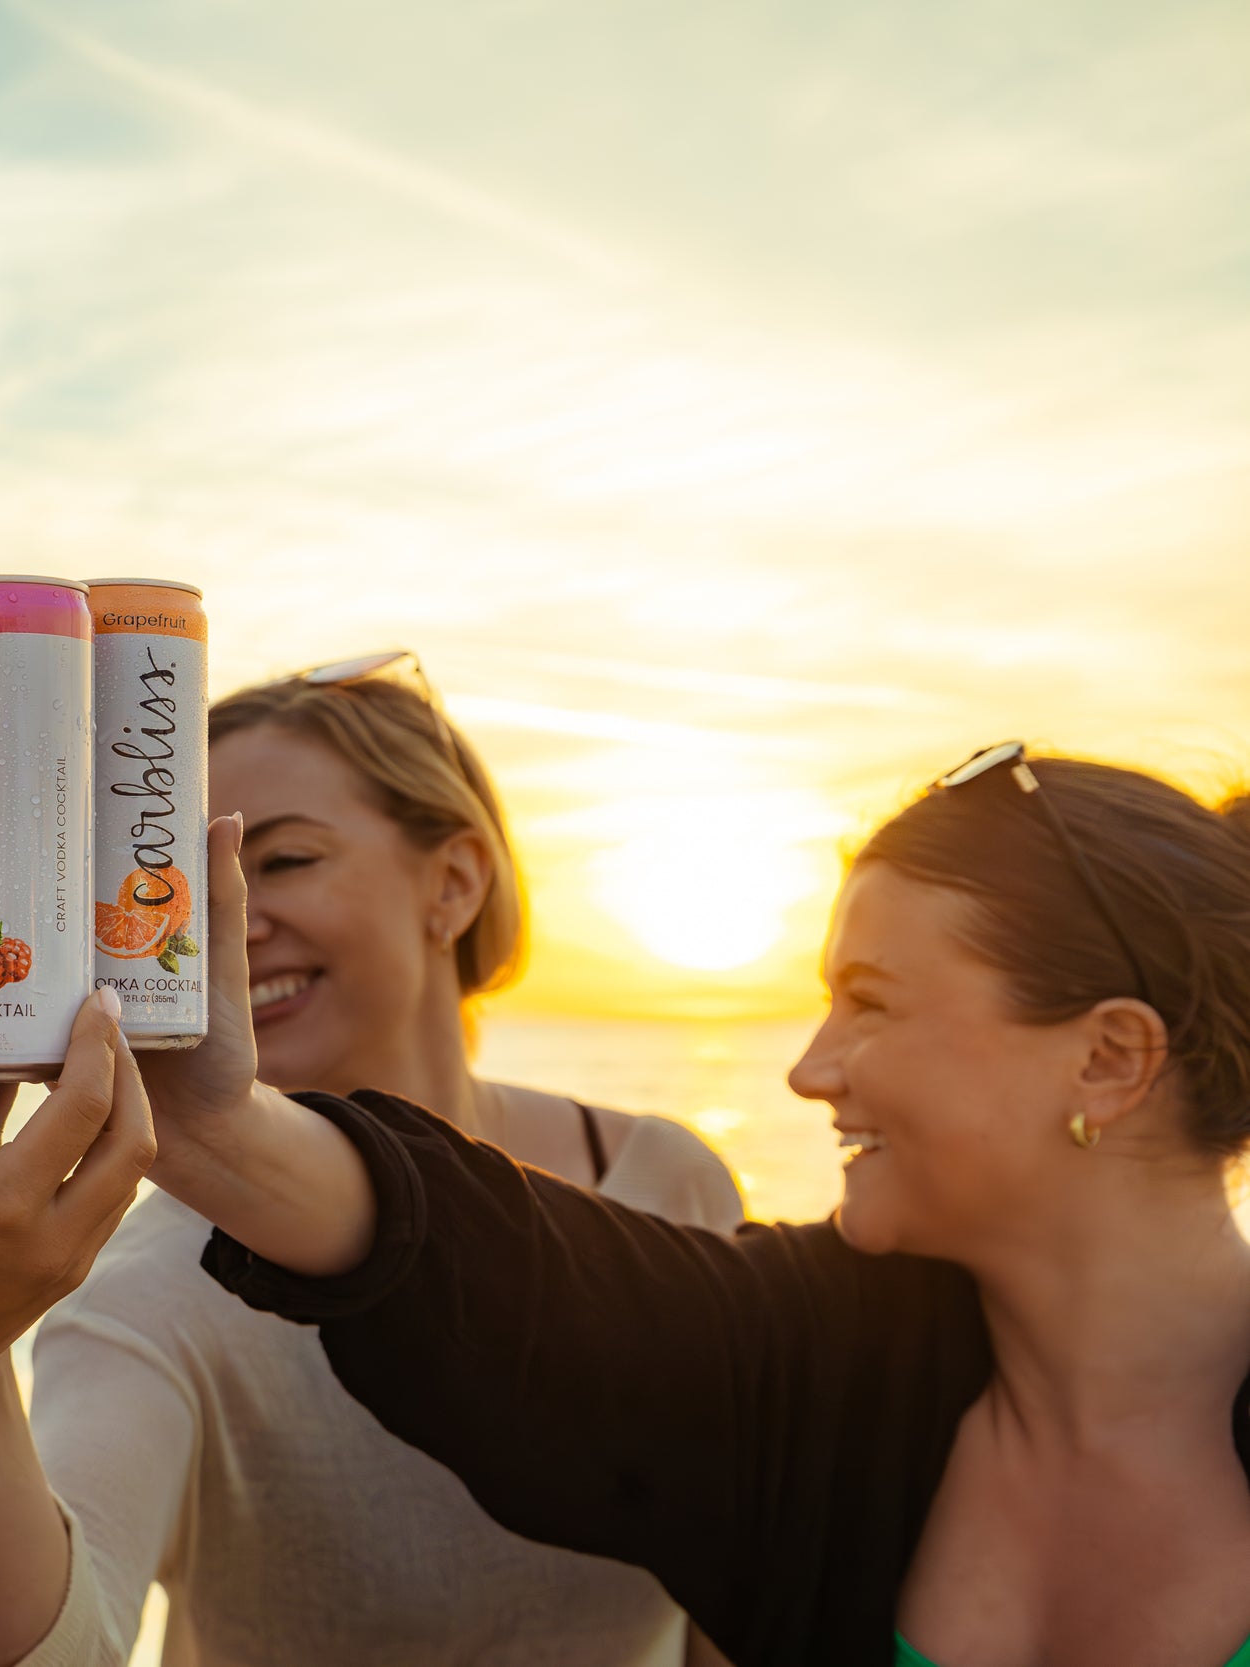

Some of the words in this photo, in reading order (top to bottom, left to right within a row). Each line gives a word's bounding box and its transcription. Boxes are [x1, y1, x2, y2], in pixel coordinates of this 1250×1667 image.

[102, 612, 187, 631] Grapefruit
[56, 756, 67, 827] COCKTAIL
[110, 645, 177, 908] carbliss
[56, 831, 66, 882] VODKA
[56, 887, 66, 932] CRAFT
[144, 978, 202, 993] COCKTAIL
